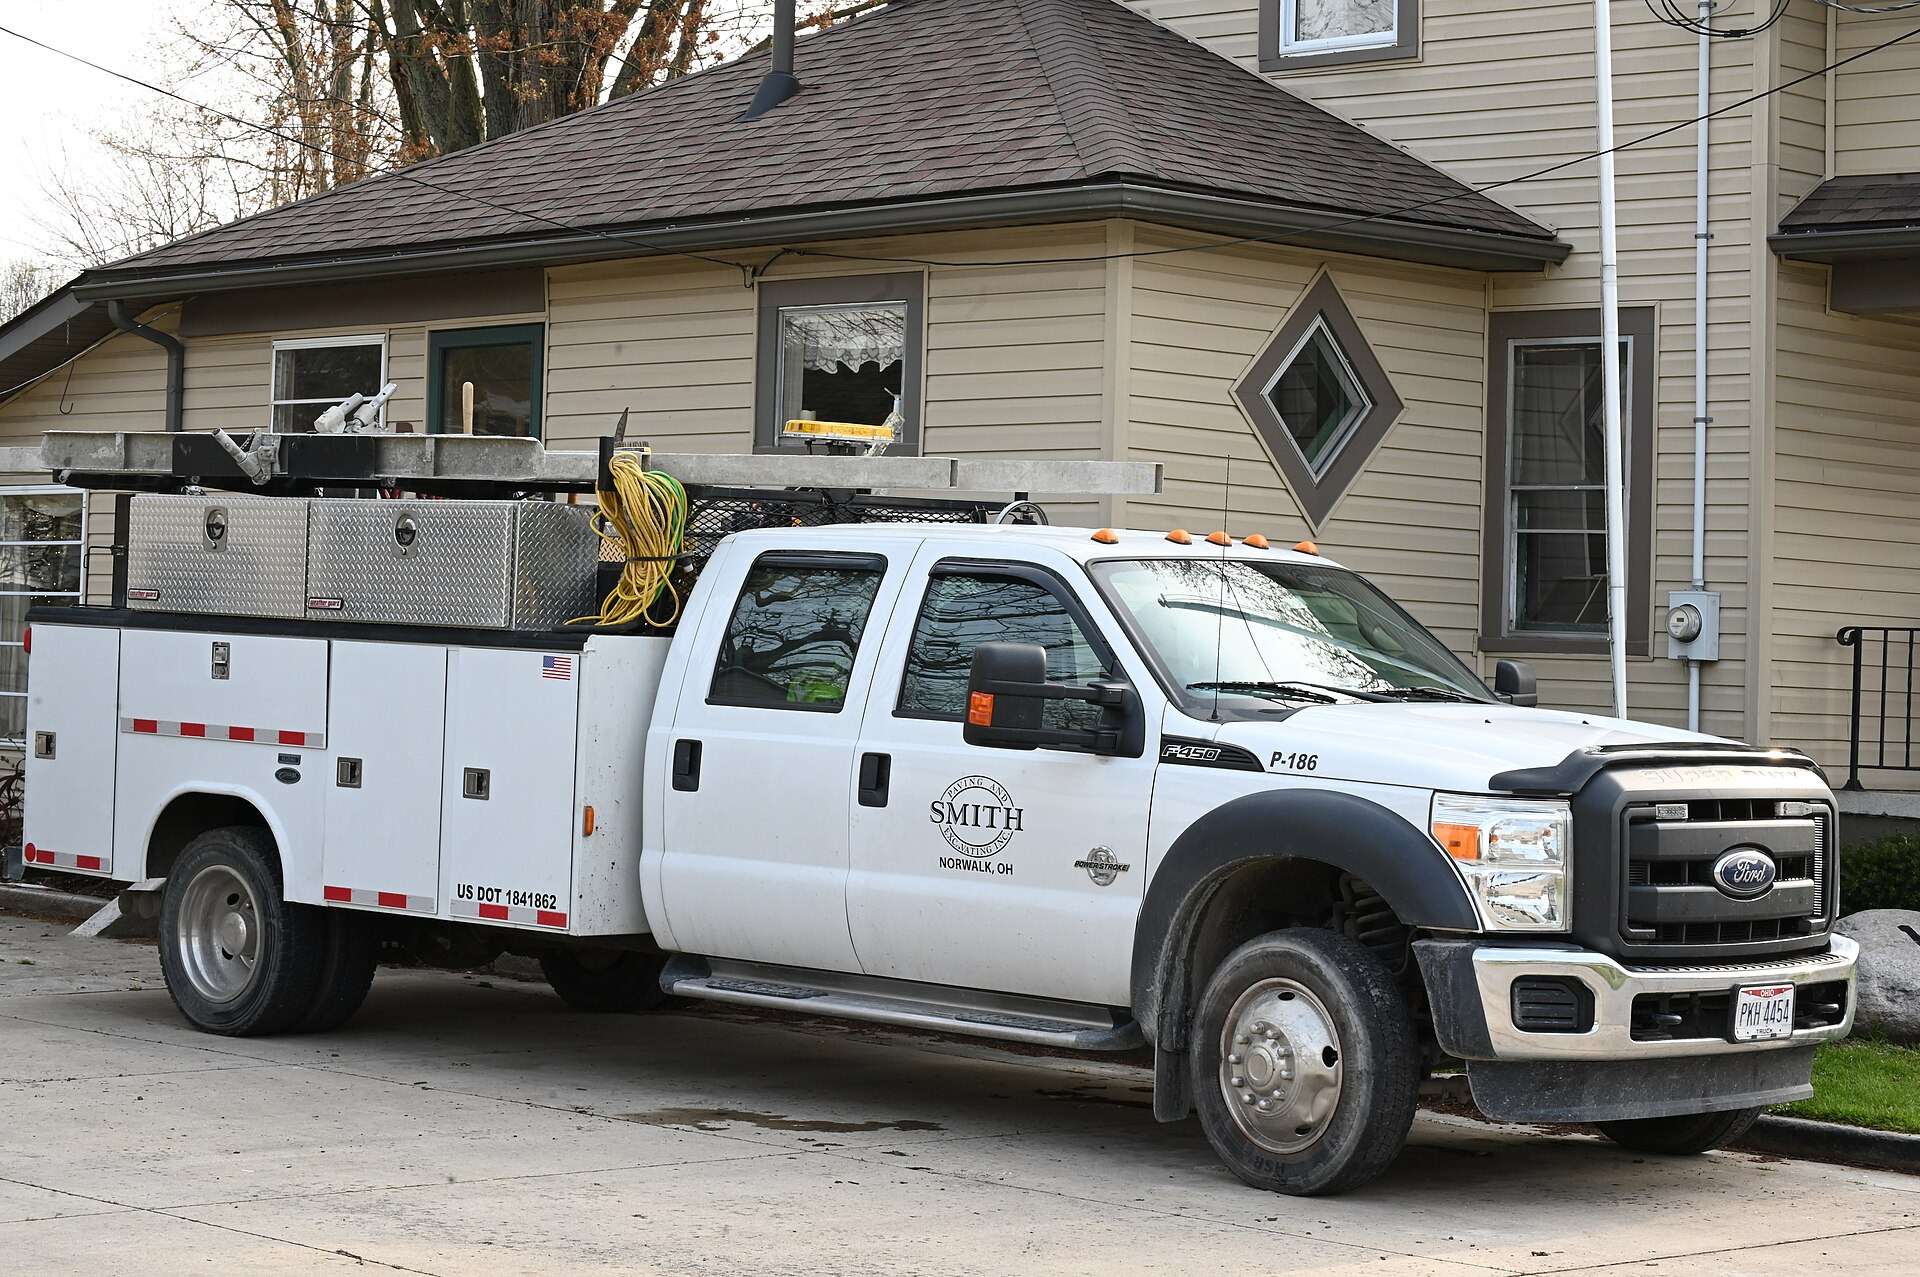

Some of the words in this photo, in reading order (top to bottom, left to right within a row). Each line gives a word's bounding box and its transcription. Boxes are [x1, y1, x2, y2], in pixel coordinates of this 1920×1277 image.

[1161, 744, 1221, 761] F-450
[1269, 751, 1319, 771] P-186
[947, 778, 983, 798] PAVING
[989, 783, 1008, 803] AND
[929, 800, 1024, 832] SMITH
[993, 832, 1010, 850] INC.
[939, 856, 995, 875] NORWALK,
[997, 862, 1013, 875] OH
[1733, 859, 1767, 884] Ford
[457, 883, 474, 900] US
[477, 886, 502, 904] DOT
[505, 889, 557, 910] 1841862
[1760, 989, 1775, 997] OHIO
[1739, 1001, 1762, 1027] PKH
[1763, 999, 1790, 1025] 4454
